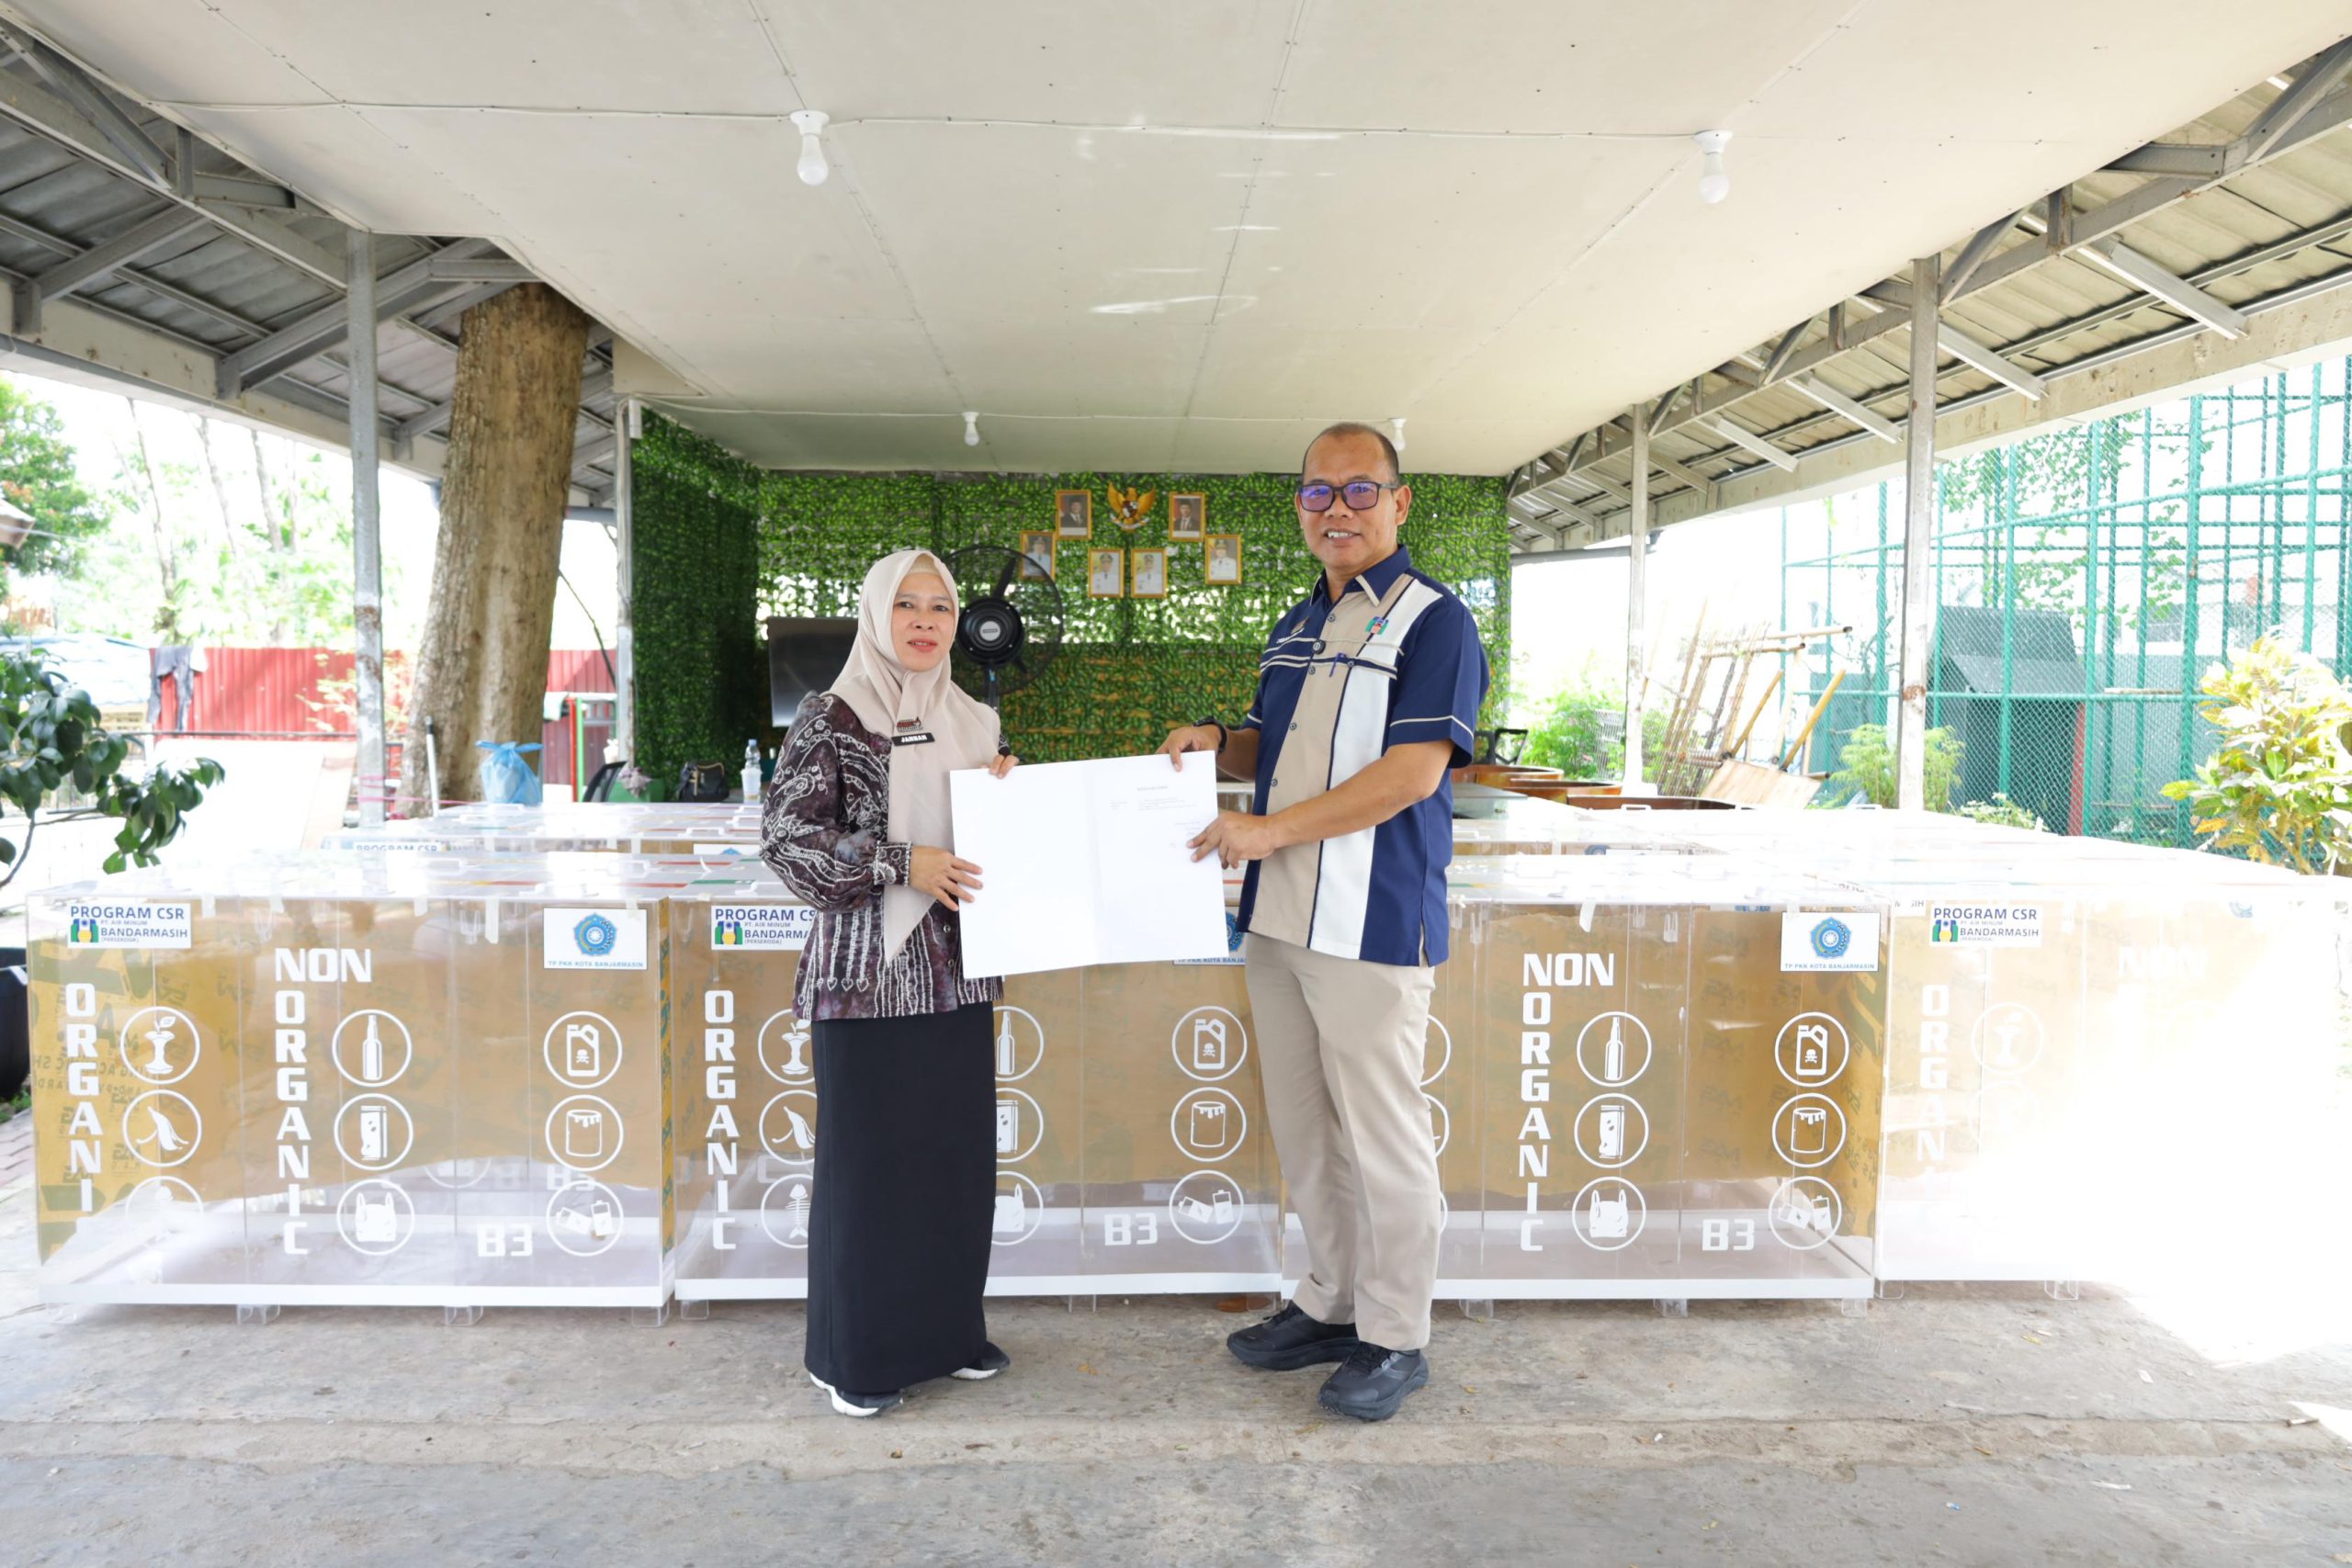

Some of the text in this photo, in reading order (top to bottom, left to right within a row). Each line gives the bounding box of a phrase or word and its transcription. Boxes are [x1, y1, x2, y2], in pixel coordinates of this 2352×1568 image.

[71, 906, 185, 919] PROGRAM CSR
[715, 908, 816, 921] PROGRAM CS
[1934, 908, 2037, 919] PROGRAM CSR
[100, 927, 188, 938] BANDARMASIH
[1960, 927, 2040, 937] BANDARMASIH
[276, 947, 371, 983] NON
[1523, 953, 1614, 987] NON
[64, 983, 103, 1213] ORGANI
[276, 990, 311, 1255] ORGANIC
[705, 989, 739, 1250] ORGANIC
[1519, 992, 1551, 1252] ORGANIC
[477, 1224, 533, 1258] B3
[1103, 1213, 1159, 1246] B3
[1702, 1219, 1756, 1251] B3
